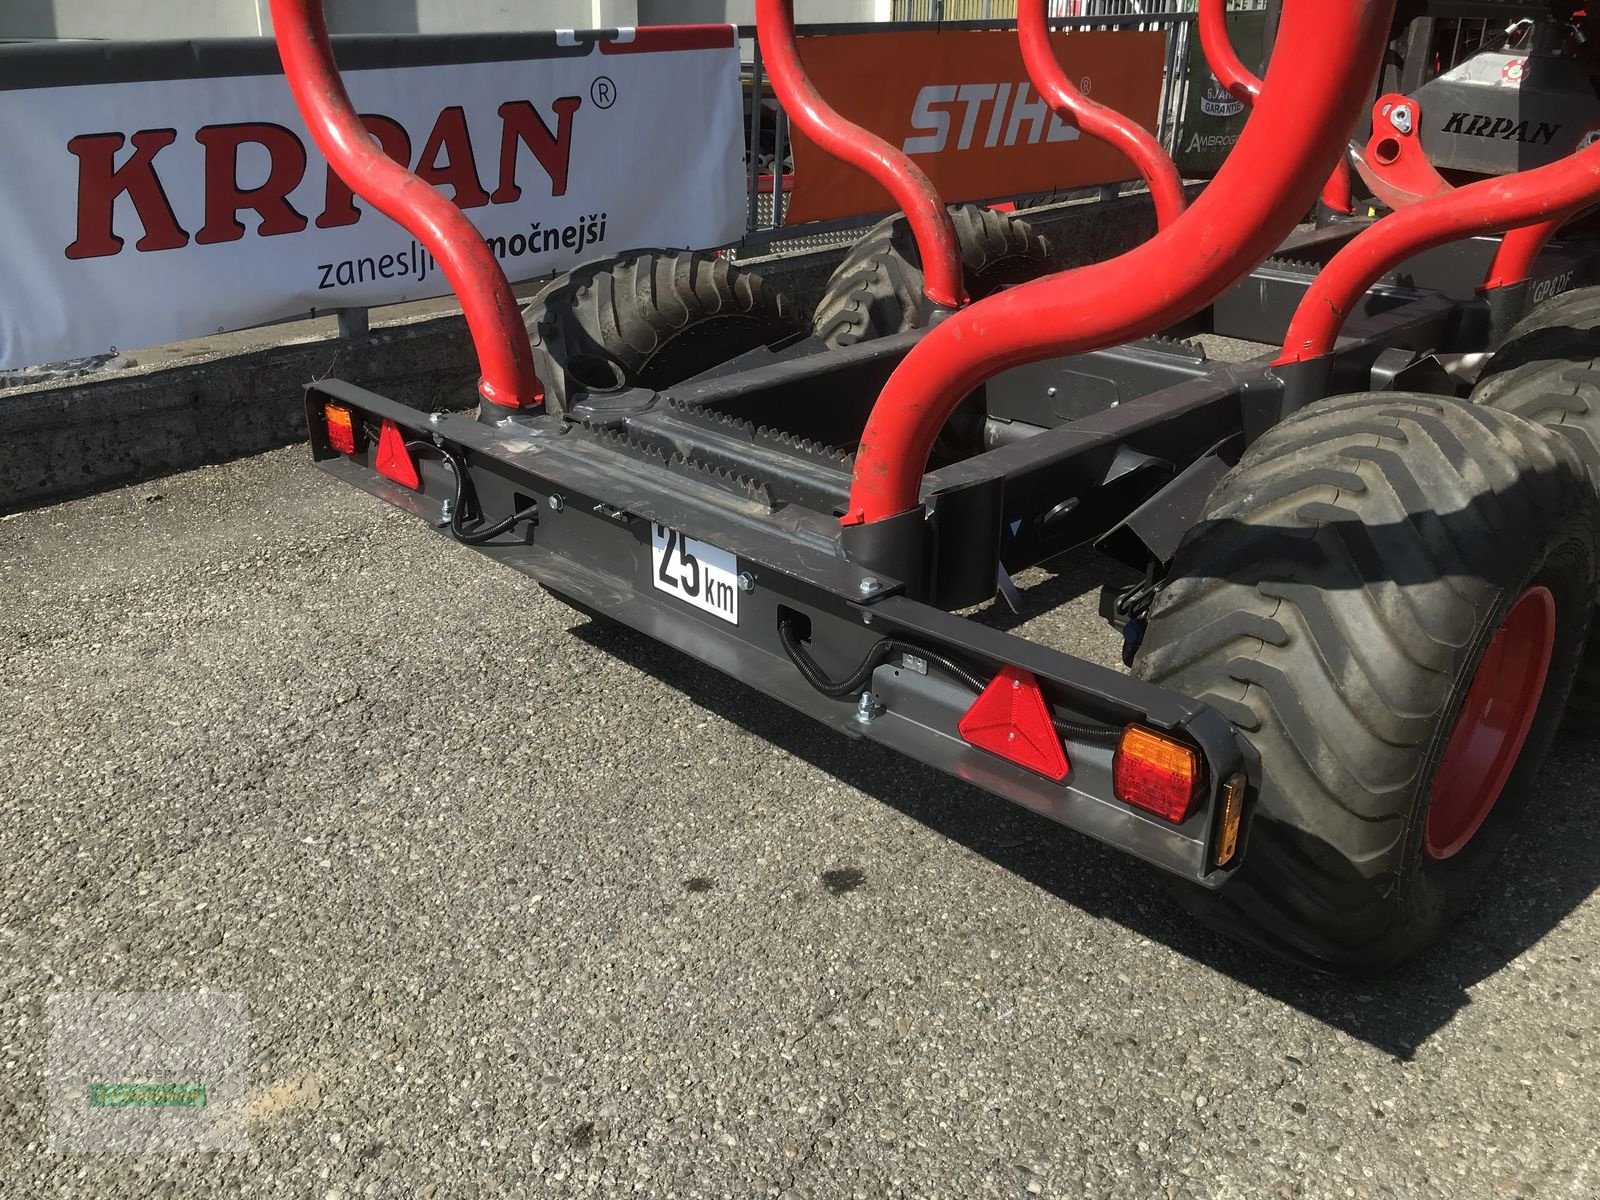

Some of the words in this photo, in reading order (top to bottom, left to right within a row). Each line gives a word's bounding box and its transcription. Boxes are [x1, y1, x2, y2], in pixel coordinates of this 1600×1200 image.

[902, 82, 1081, 155] STIHL
[1185, 132, 1240, 152] AMBROG
[1204, 102, 1241, 114] GARANTIE
[1441, 112, 1562, 145] KRPAN
[64, 95, 582, 260] KRPAN
[317, 240, 436, 290] zaneslji
[486, 213, 607, 258] močnejši
[657, 525, 700, 598] 25
[705, 566, 734, 615] km
